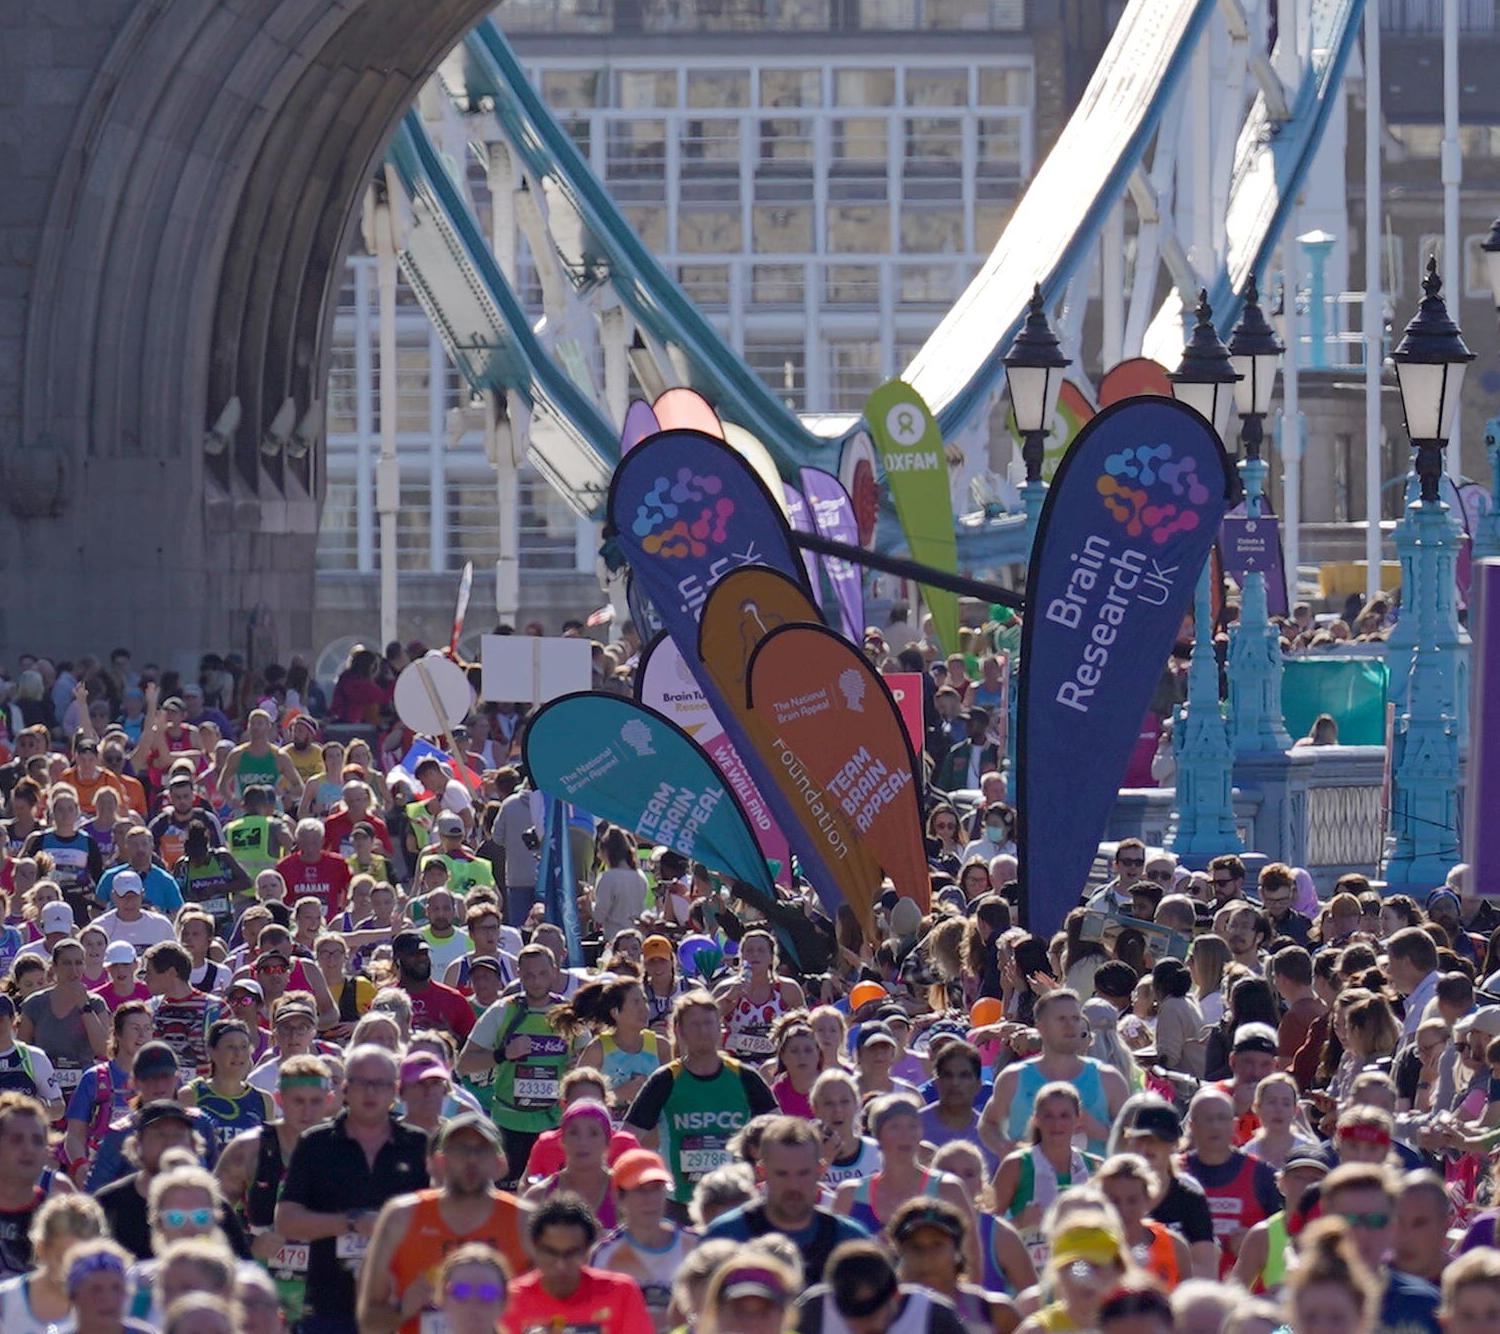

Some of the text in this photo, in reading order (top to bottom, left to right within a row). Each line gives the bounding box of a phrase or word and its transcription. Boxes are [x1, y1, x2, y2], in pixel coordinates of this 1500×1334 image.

[885, 451, 939, 472] OXFAM
[1046, 534, 1110, 629] Brain
[1137, 559, 1180, 607] UK
[1055, 548, 1147, 712] Research
[663, 691, 693, 702] Brain
[714, 746, 729, 769] WE
[726, 767, 749, 804] WILL
[744, 799, 771, 831] FIND
[772, 737, 851, 860] Foundation
[826, 746, 871, 799] TEAM
[841, 759, 888, 816] BRAIN
[635, 782, 676, 837] TEAM
[655, 787, 696, 847] BRAIN
[676, 786, 724, 856] APPEAL
[855, 768, 913, 833] APPEAL
[294, 883, 330, 893] GRAHAM
[518, 1080, 554, 1095] 23336
[674, 1111, 744, 1130] NSPCC
[687, 1150, 727, 1167] 29786
[277, 1248, 307, 1266] 479
